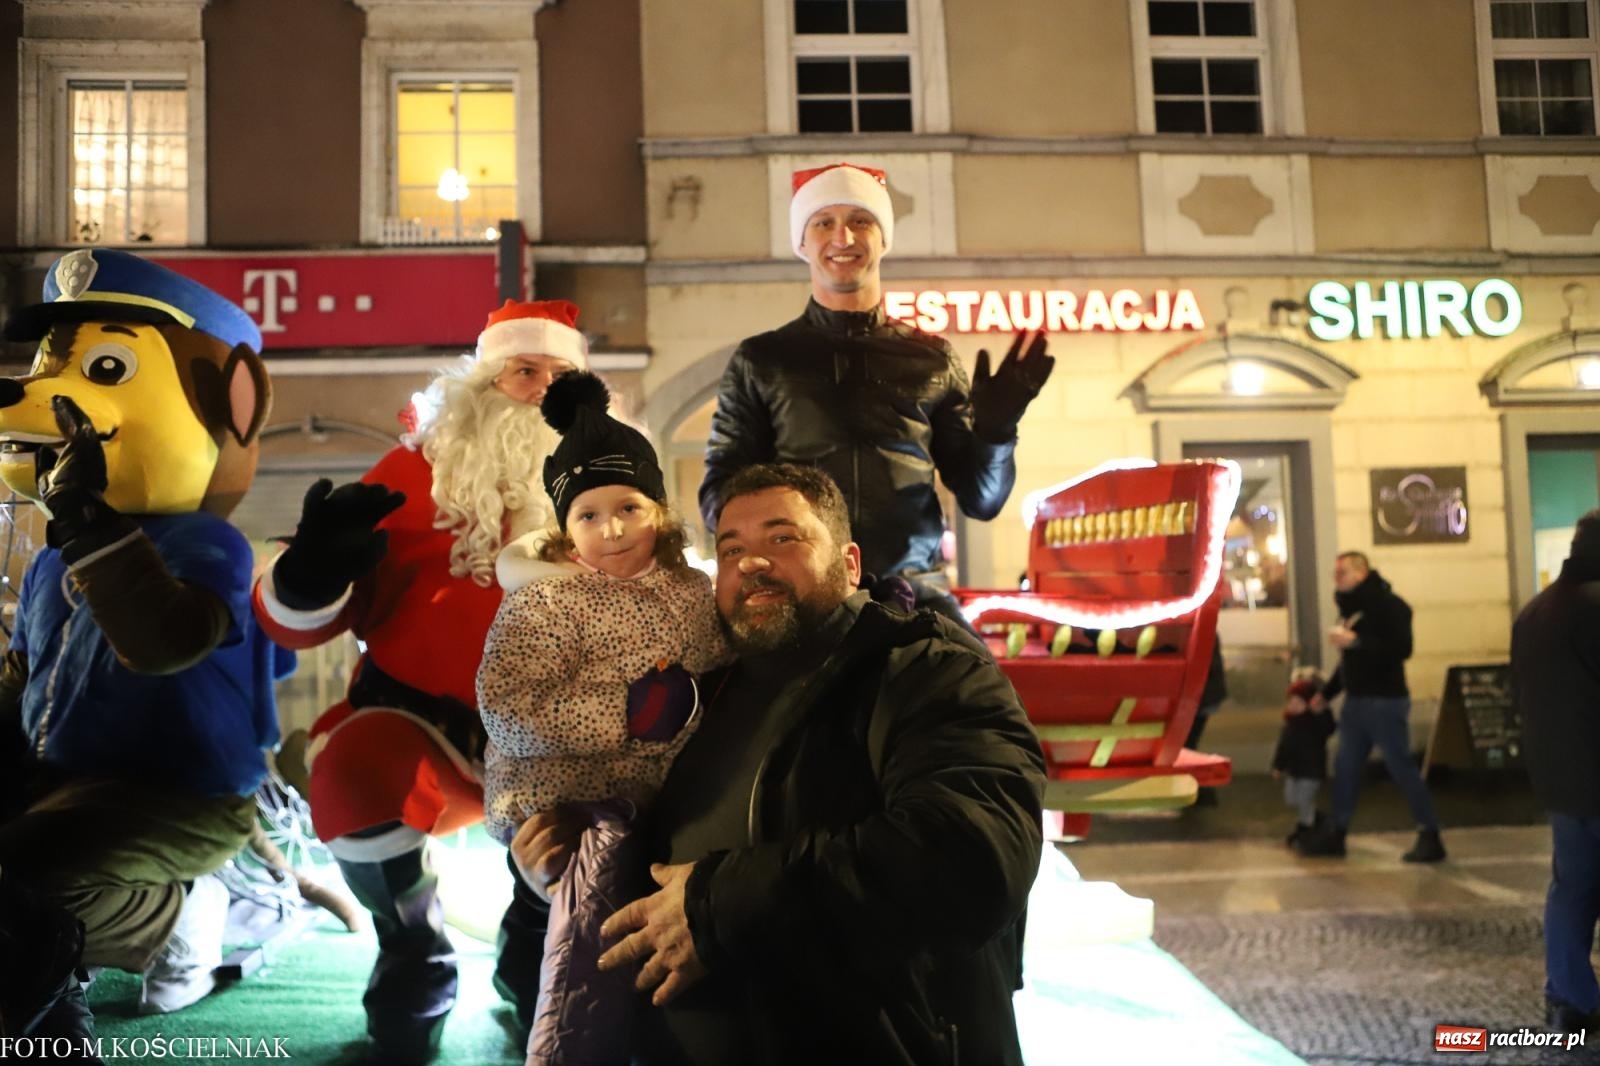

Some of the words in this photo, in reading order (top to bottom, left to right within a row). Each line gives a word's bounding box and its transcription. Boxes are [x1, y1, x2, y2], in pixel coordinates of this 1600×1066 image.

[243, 269, 297, 332] T
[884, 289, 1205, 332] ESTAURACJA
[1308, 278, 1522, 341] SHIRO
